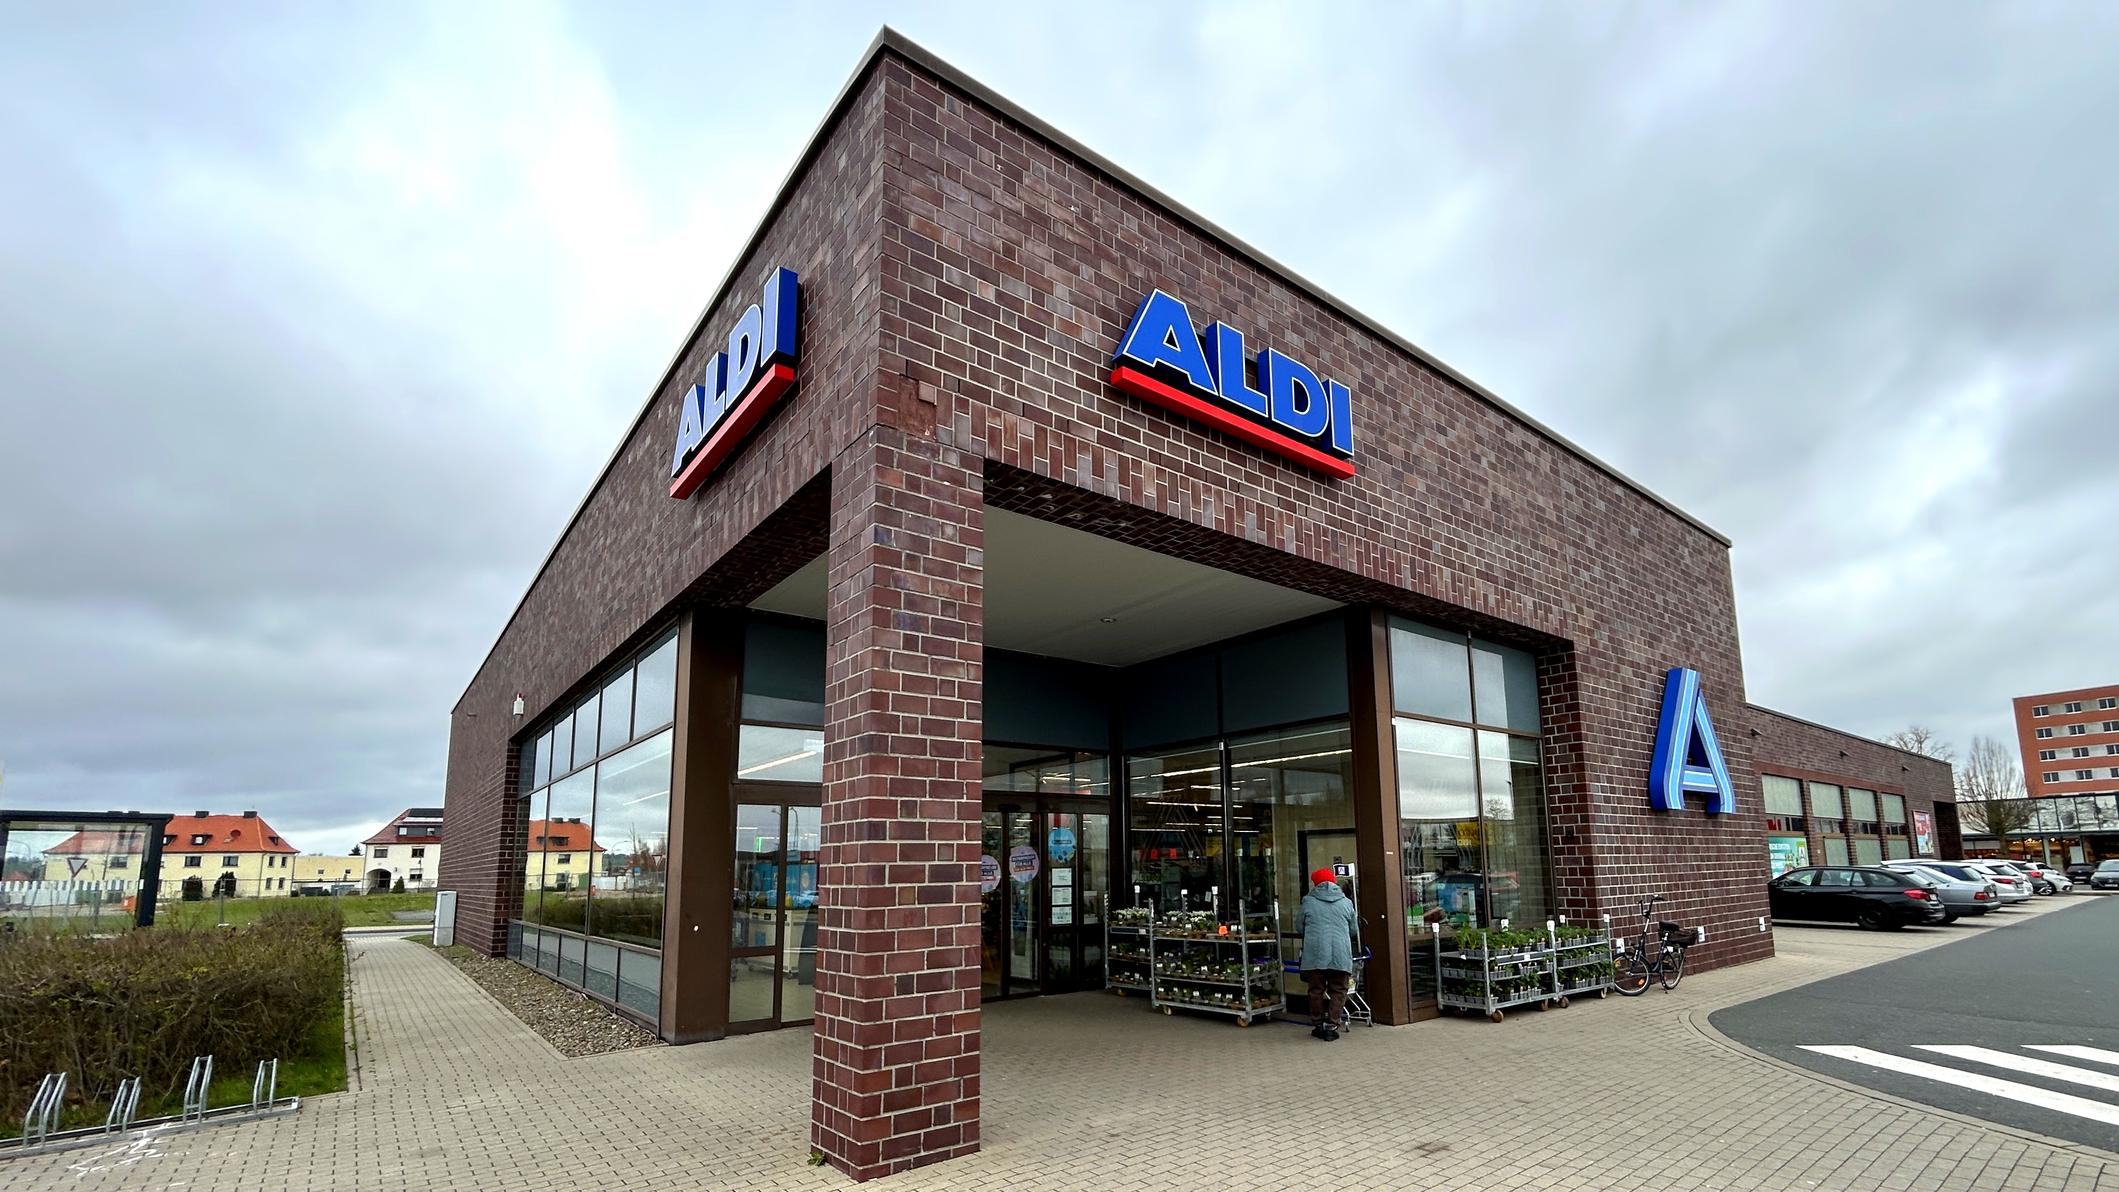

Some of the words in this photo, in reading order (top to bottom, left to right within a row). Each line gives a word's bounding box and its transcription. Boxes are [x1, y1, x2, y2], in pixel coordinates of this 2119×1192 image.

[671, 266, 780, 477] ALDI
[1122, 288, 1355, 457] ALDI
[1662, 667, 1736, 814] A
